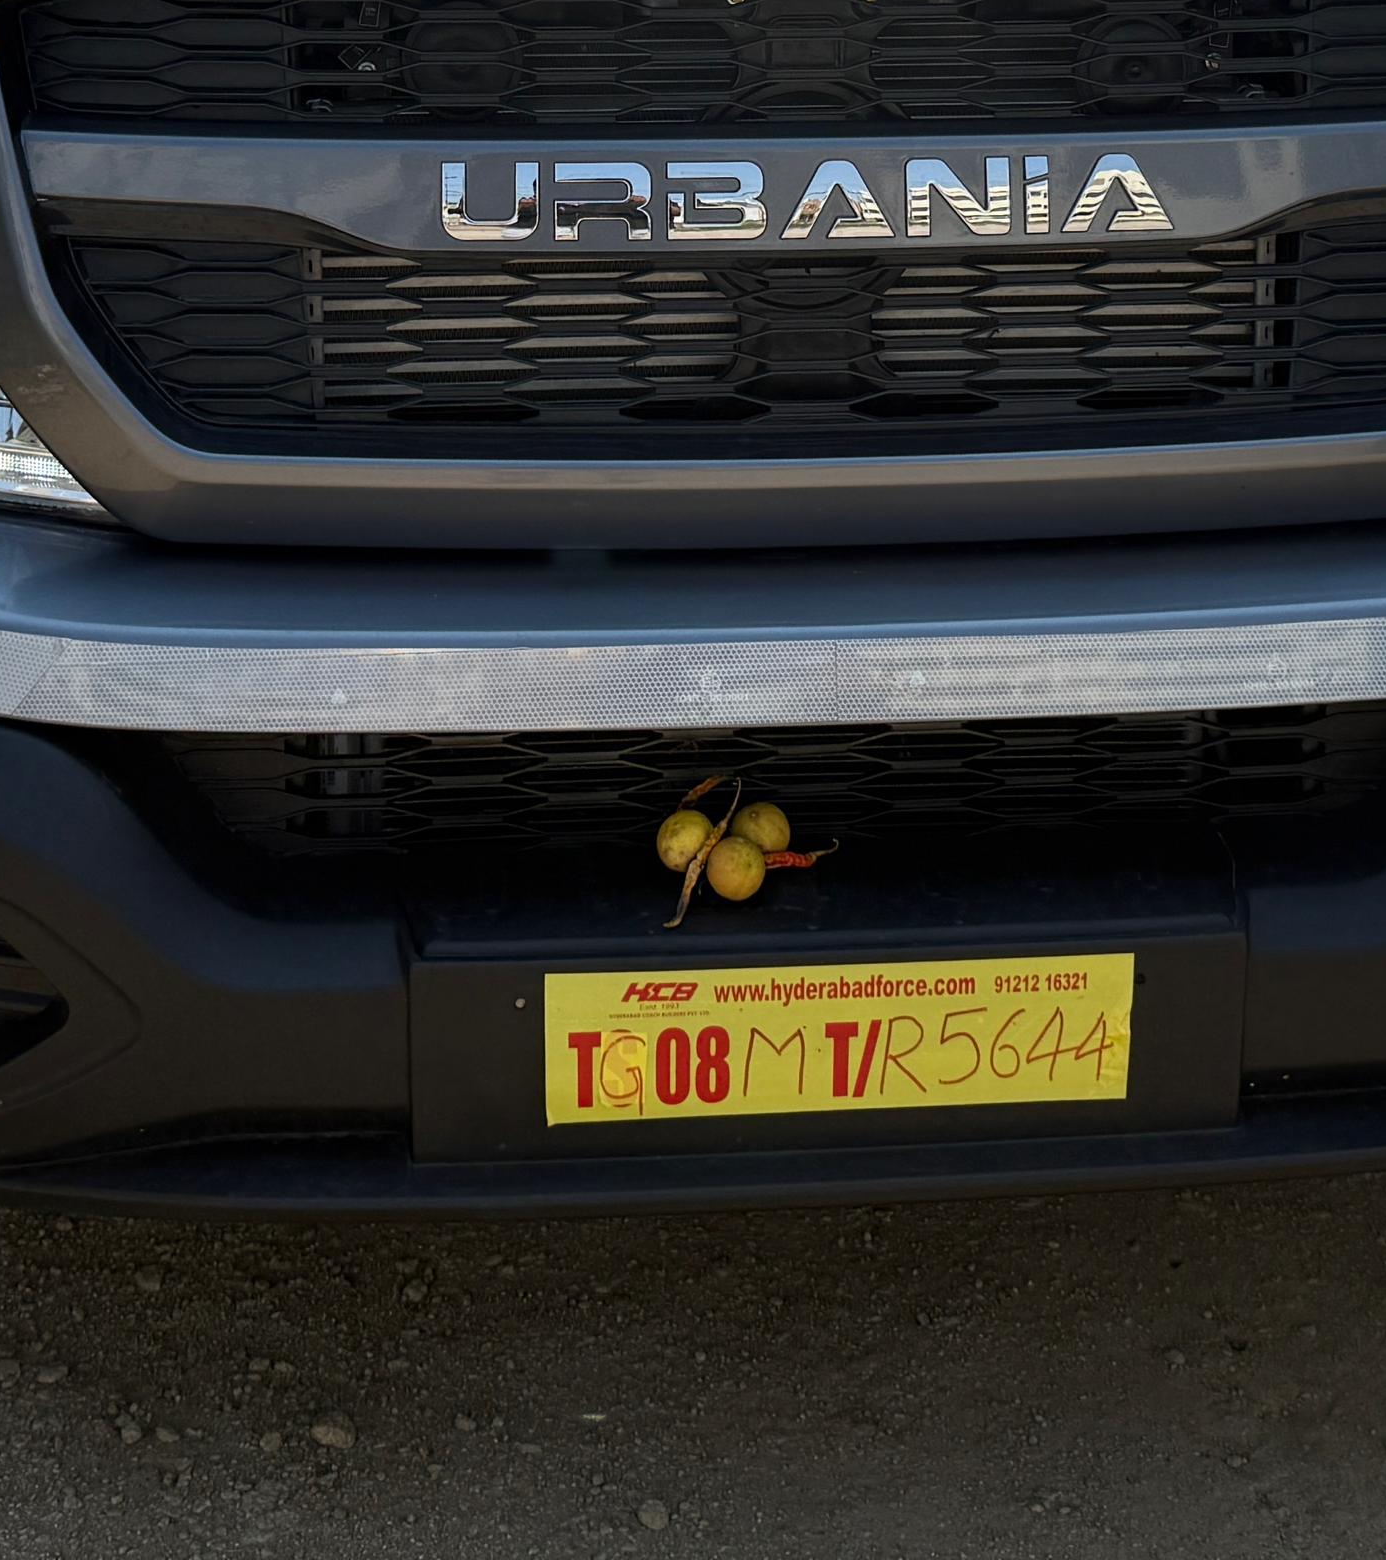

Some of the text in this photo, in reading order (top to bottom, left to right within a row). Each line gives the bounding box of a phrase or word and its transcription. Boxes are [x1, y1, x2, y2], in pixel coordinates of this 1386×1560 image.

[714, 974, 976, 1008] www.hyderabadforce.com
[994, 974, 1040, 994] 91212
[1044, 972, 1089, 992] 16321
